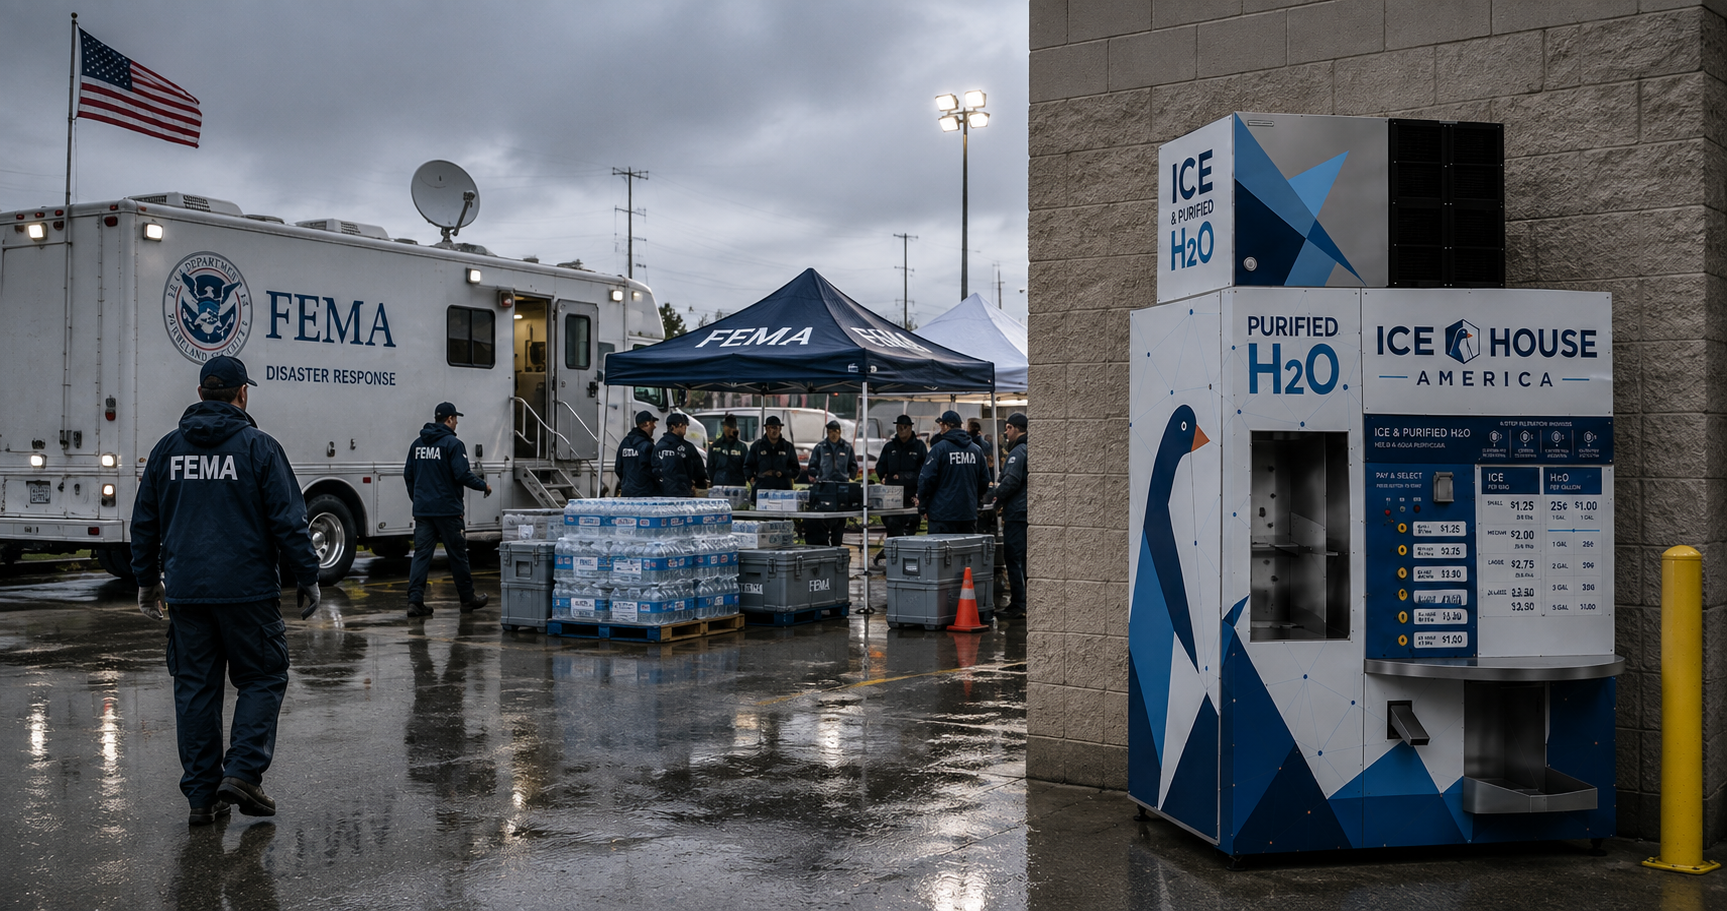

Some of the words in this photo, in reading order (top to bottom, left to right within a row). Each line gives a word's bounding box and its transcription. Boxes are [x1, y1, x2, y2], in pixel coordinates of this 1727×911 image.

[1172, 149, 1213, 204] ICE
[1171, 211, 1177, 225] &
[1178, 199, 1214, 224] PURIFIED
[1171, 221, 1214, 271] H2O
[266, 290, 397, 348] FEMA
[1248, 316, 1339, 337] PURIFIED
[694, 326, 814, 349] FEMA
[1377, 325, 1434, 356] ICE
[1490, 327, 1598, 358] HOUSE
[266, 365, 329, 383] DISASTER
[333, 369, 397, 386] RESPONSE
[1248, 343, 1340, 395] H2O
[1416, 370, 1554, 387] AMERICA
[1374, 427, 1390, 437] ICE
[1392, 427, 1400, 437] &
[1402, 427, 1448, 438] PURIFIED
[1450, 428, 1471, 438] H2O
[415, 446, 441, 460] FEMA
[949, 451, 976, 465] FEMA
[170, 455, 238, 480] FEMA
[1396, 472, 1423, 480] SELECT
[1487, 473, 1504, 482] ICE
[1510, 501, 1534, 511] $1.25
[1550, 501, 1568, 511] 25¢
[1574, 501, 1598, 511] $1.00
[1440, 524, 1461, 534] $1.25
[1510, 530, 1535, 540] $2.00
[1510, 559, 1535, 569] $2.75
[808, 578, 831, 592] FEMA
